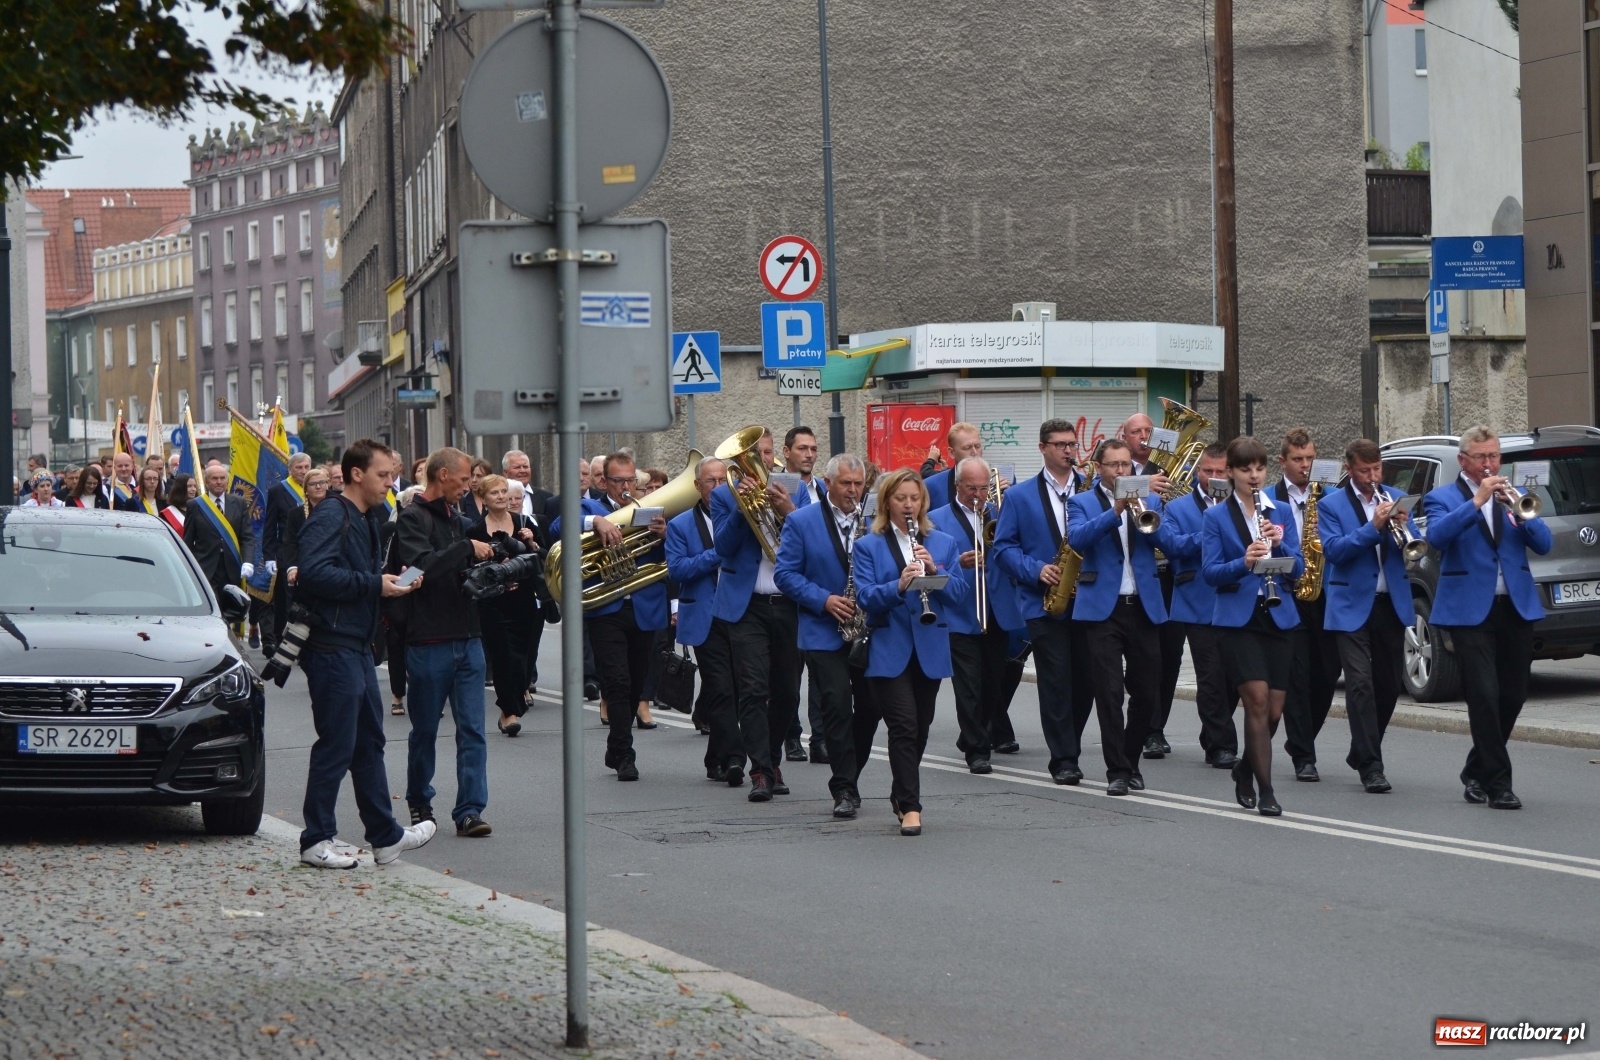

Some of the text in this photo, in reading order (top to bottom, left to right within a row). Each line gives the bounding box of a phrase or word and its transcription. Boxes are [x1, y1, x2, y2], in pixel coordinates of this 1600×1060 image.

[1433, 290, 1444, 327] P
[777, 309, 813, 360] P
[929, 331, 1041, 350] karta telegrosik
[1169, 335, 1213, 353] telegrosik
[789, 348, 822, 360] płatny
[935, 356, 1034, 365] najtańsze rozmowy międzynarodowe
[779, 373, 821, 389] Koniec
[1563, 583, 1590, 598] SRC
[33, 728, 131, 748] SR 2629L
